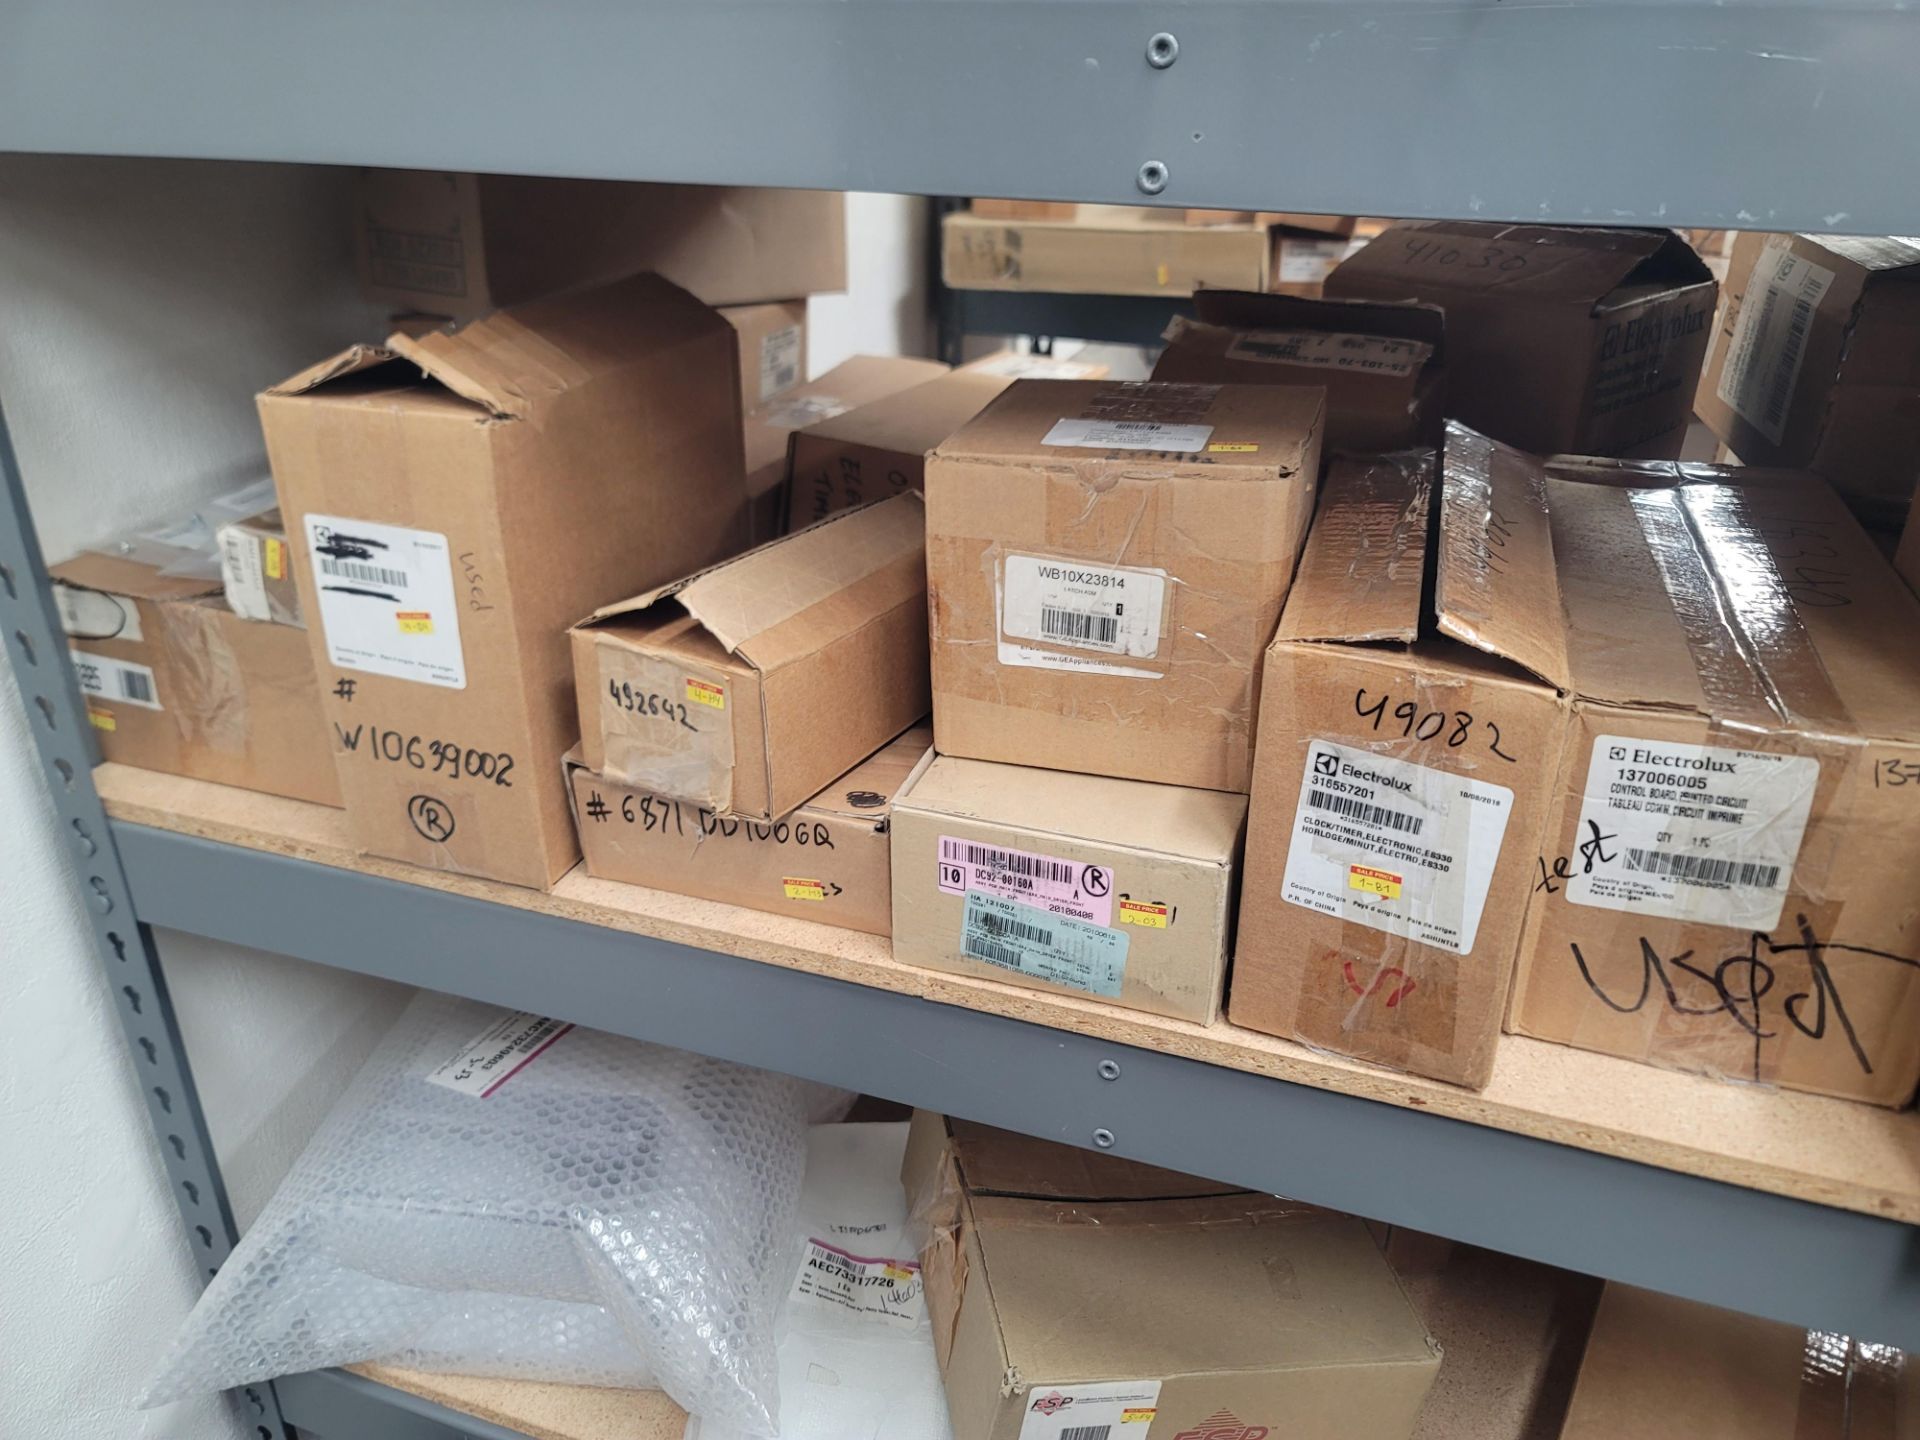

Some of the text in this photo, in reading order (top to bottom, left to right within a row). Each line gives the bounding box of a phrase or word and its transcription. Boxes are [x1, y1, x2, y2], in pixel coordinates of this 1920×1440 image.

[1038, 566, 1125, 590] WB10X23814
[609, 678, 698, 732] 492642
[1356, 688, 1517, 763] 49082
[1633, 749, 1736, 774] Electrolux
[1342, 764, 1413, 793] Electrolux
[1618, 768, 1708, 790] 137006005
[1611, 783, 1646, 797] CONTROL
[586, 790, 613, 823] #
[622, 795, 684, 836] 6871
[1608, 797, 1642, 811] TABLEAU
[943, 867, 960, 883] 10
[1356, 868, 1374, 877] SALE
[975, 868, 1079, 900] DC92-00160A A
[1290, 881, 1316, 895] Country
[1049, 904, 1094, 920] 20100408
[1126, 903, 1160, 914] SALE PRICE
[1314, 901, 1336, 913] CHINA
[808, 1258, 895, 1288] AEC73317726
[1030, 1396, 1074, 1411] FSP
